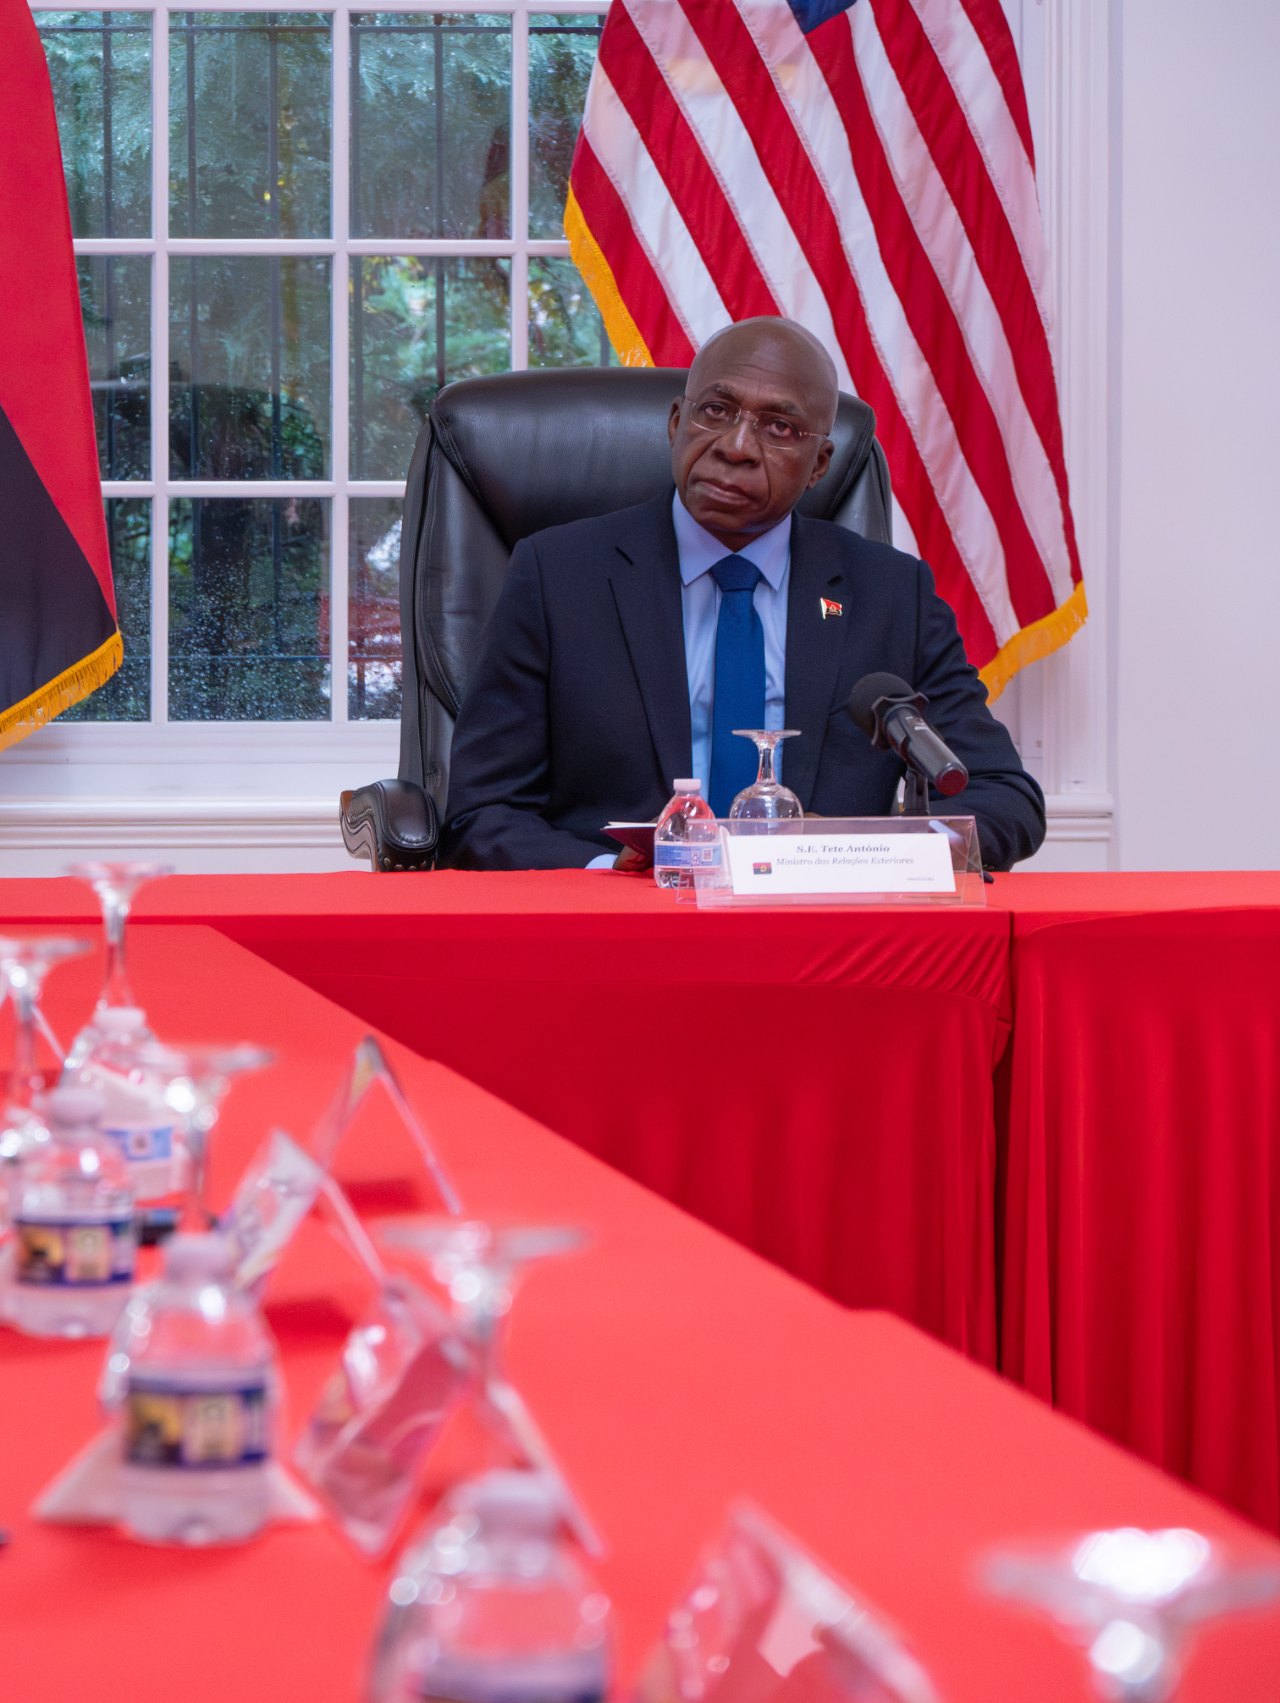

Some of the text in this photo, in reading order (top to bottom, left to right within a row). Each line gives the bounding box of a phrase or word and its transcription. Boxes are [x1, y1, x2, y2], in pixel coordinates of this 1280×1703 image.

[821, 844, 844, 853] Tete
[776, 857, 914, 867] Ministro das Relações Exteriores
